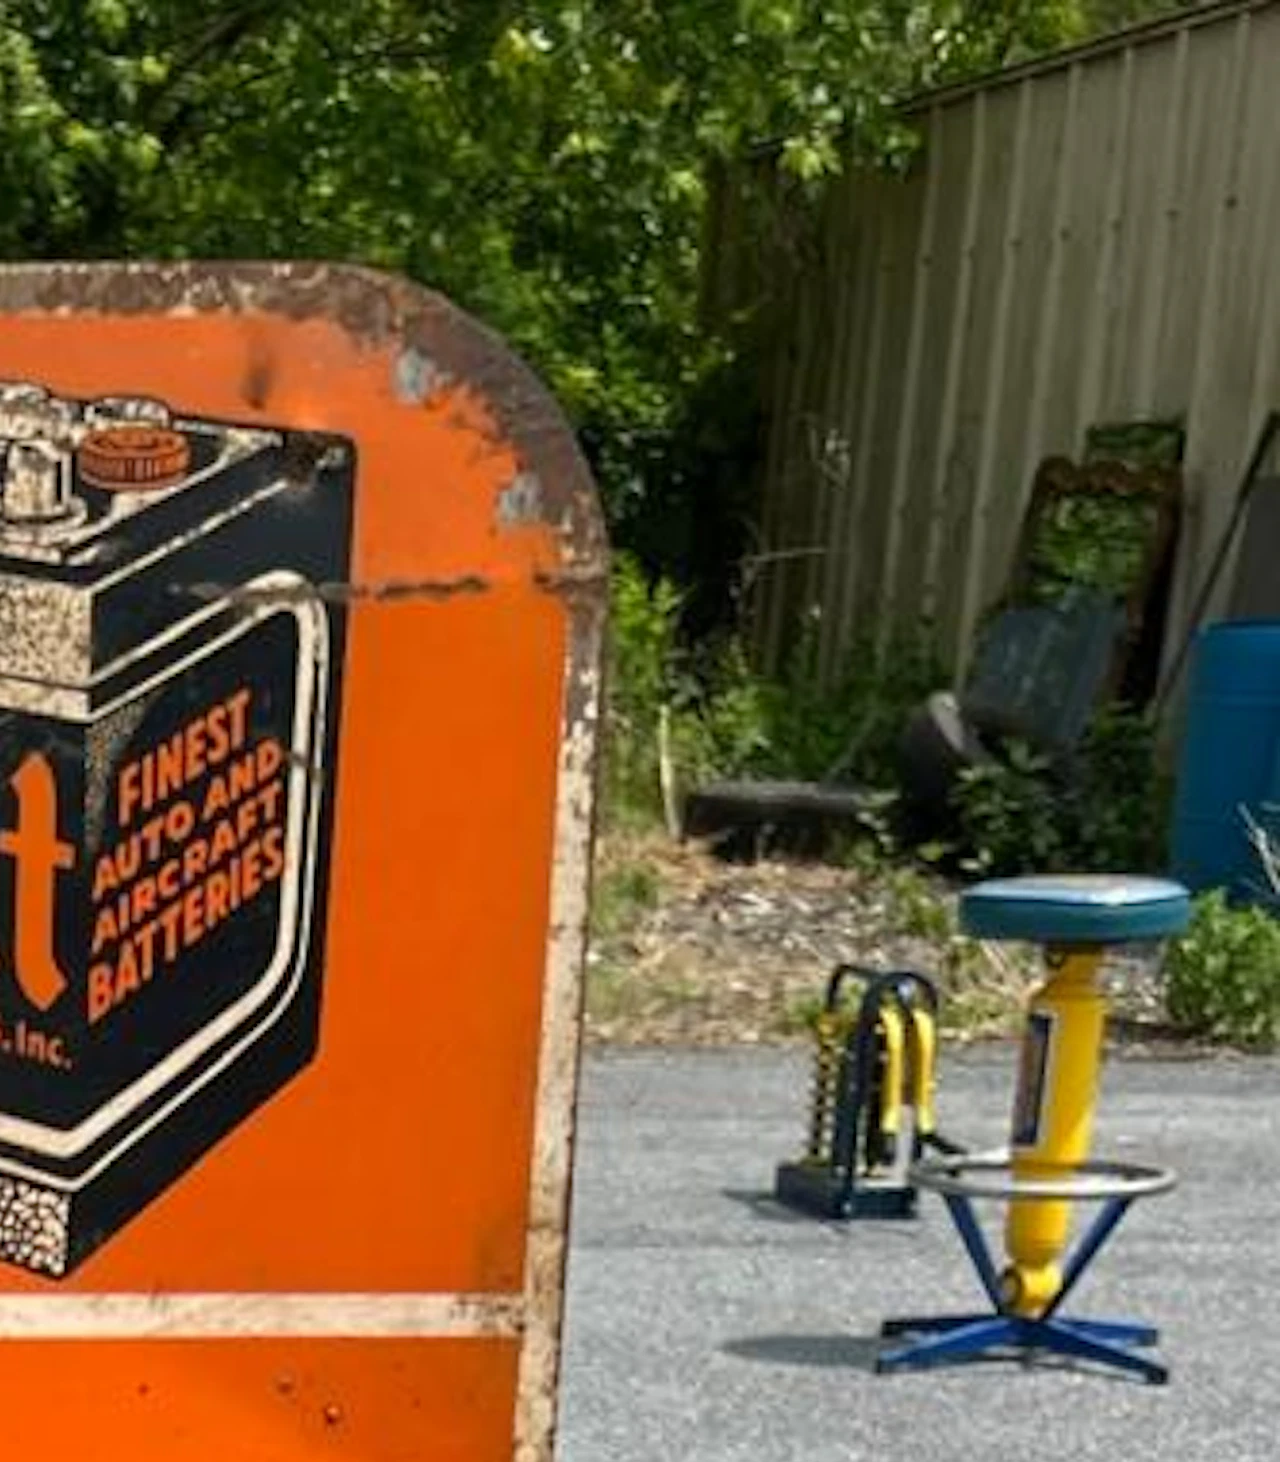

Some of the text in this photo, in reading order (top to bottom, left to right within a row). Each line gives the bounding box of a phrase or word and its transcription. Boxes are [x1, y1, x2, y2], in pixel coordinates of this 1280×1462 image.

[92, 740, 283, 900] AUTO AND
[118, 687, 251, 826] FINEST
[88, 827, 284, 1023] BATTERIES
[91, 780, 283, 953] AIRCRAFT
